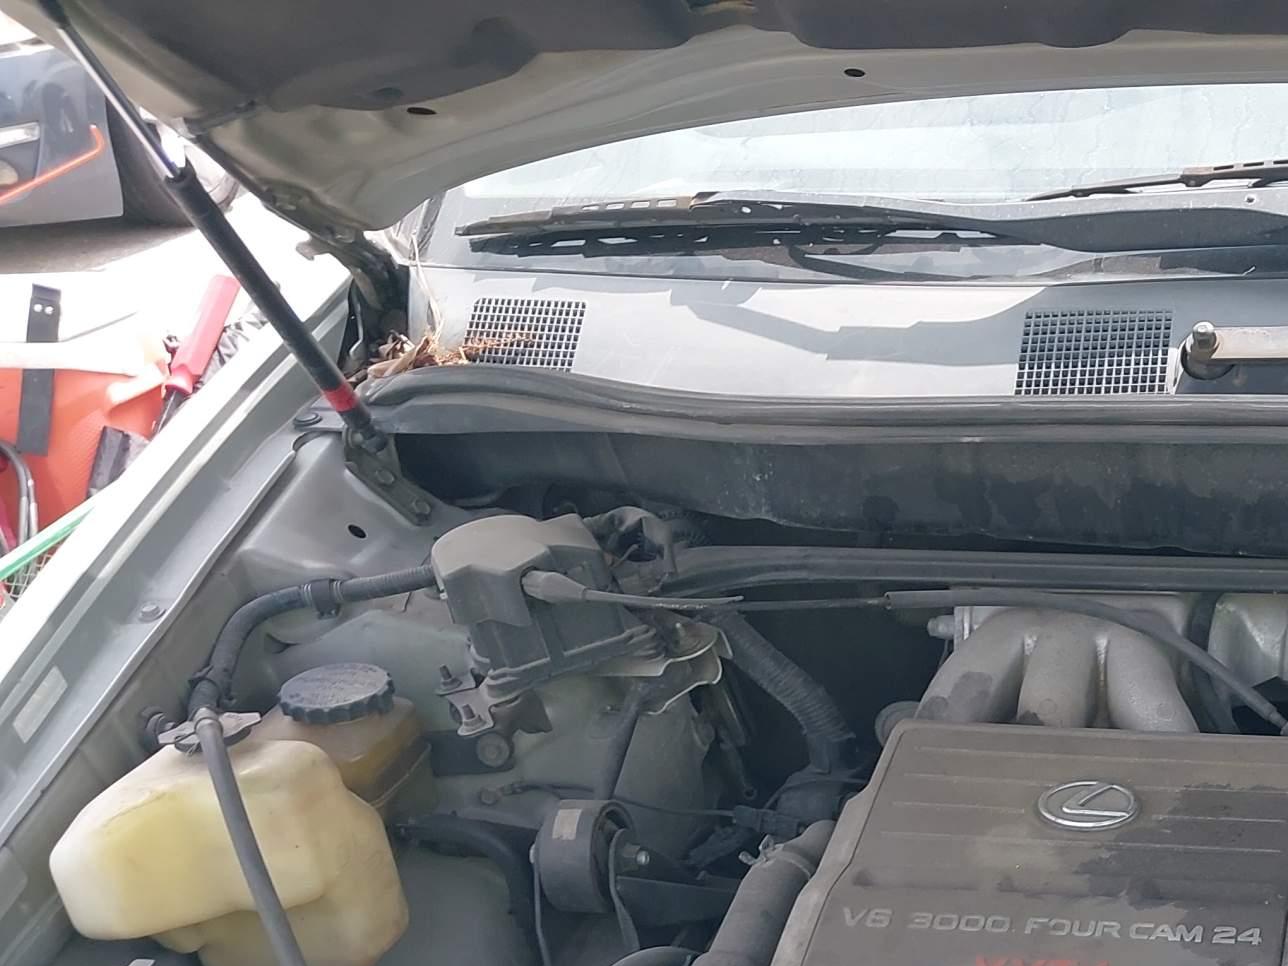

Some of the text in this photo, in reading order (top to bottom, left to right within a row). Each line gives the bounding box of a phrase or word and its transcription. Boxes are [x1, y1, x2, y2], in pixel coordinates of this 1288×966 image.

[842, 906, 1262, 946] V6 3000 FOUR CAM 24
